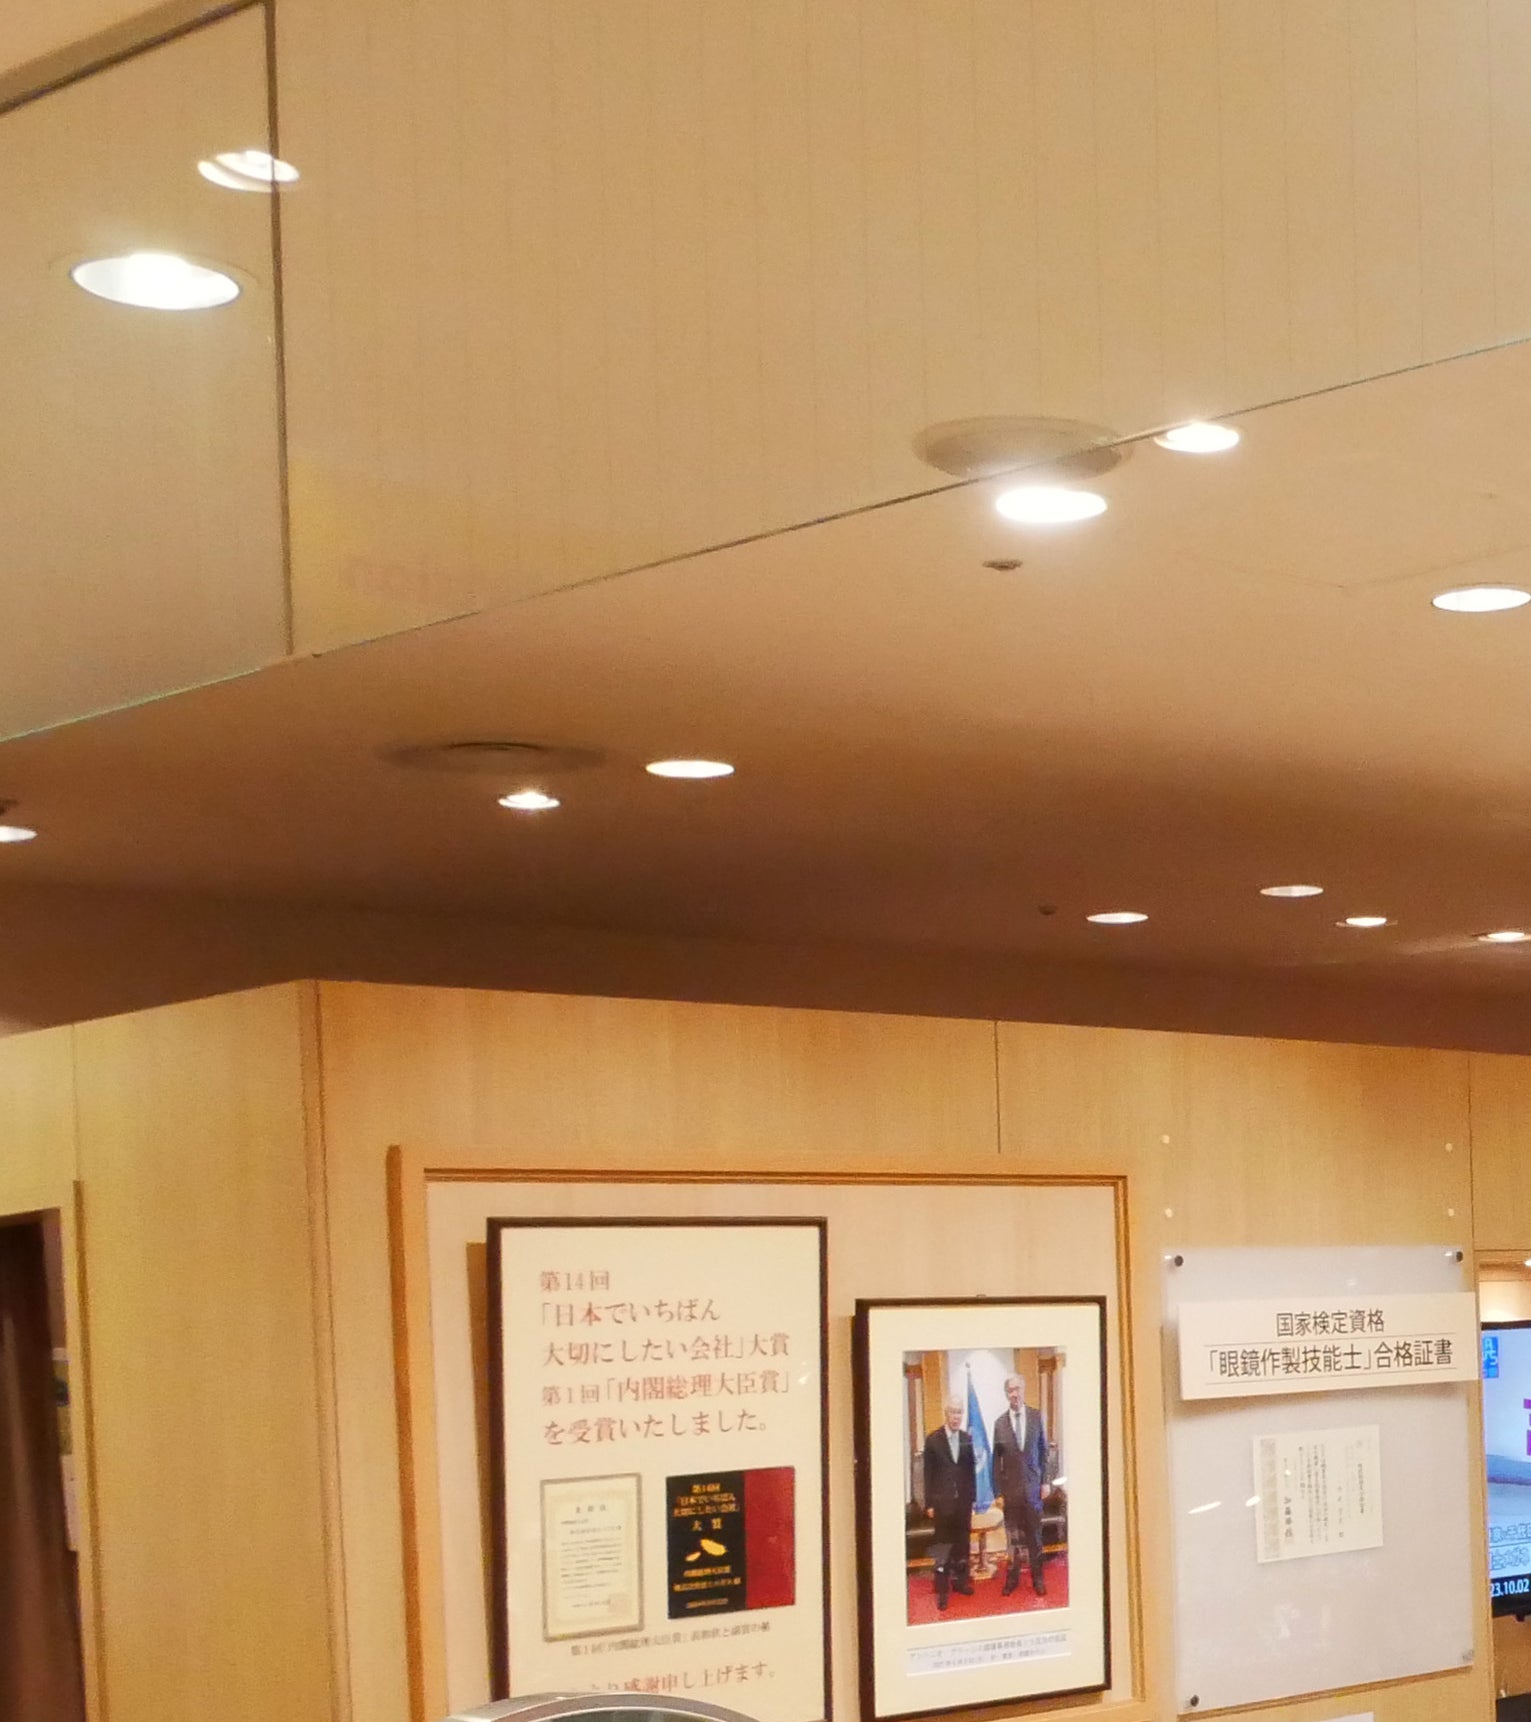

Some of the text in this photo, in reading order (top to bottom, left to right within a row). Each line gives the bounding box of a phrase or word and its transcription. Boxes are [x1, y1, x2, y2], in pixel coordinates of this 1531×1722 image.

[540, 1270, 610, 1292] 第14回
[541, 1298, 720, 1327] 「日本でいちばん
[1276, 1308, 1385, 1337] 国家検定資格
[543, 1332, 790, 1367] 大切にしたい会社」大賞
[1209, 1338, 1453, 1378] 「眼鏡作製技能士」合格証書
[544, 1409, 767, 1445] を受賞いたしました。
[591, 1662, 776, 1693] 感謝申し上げます。
